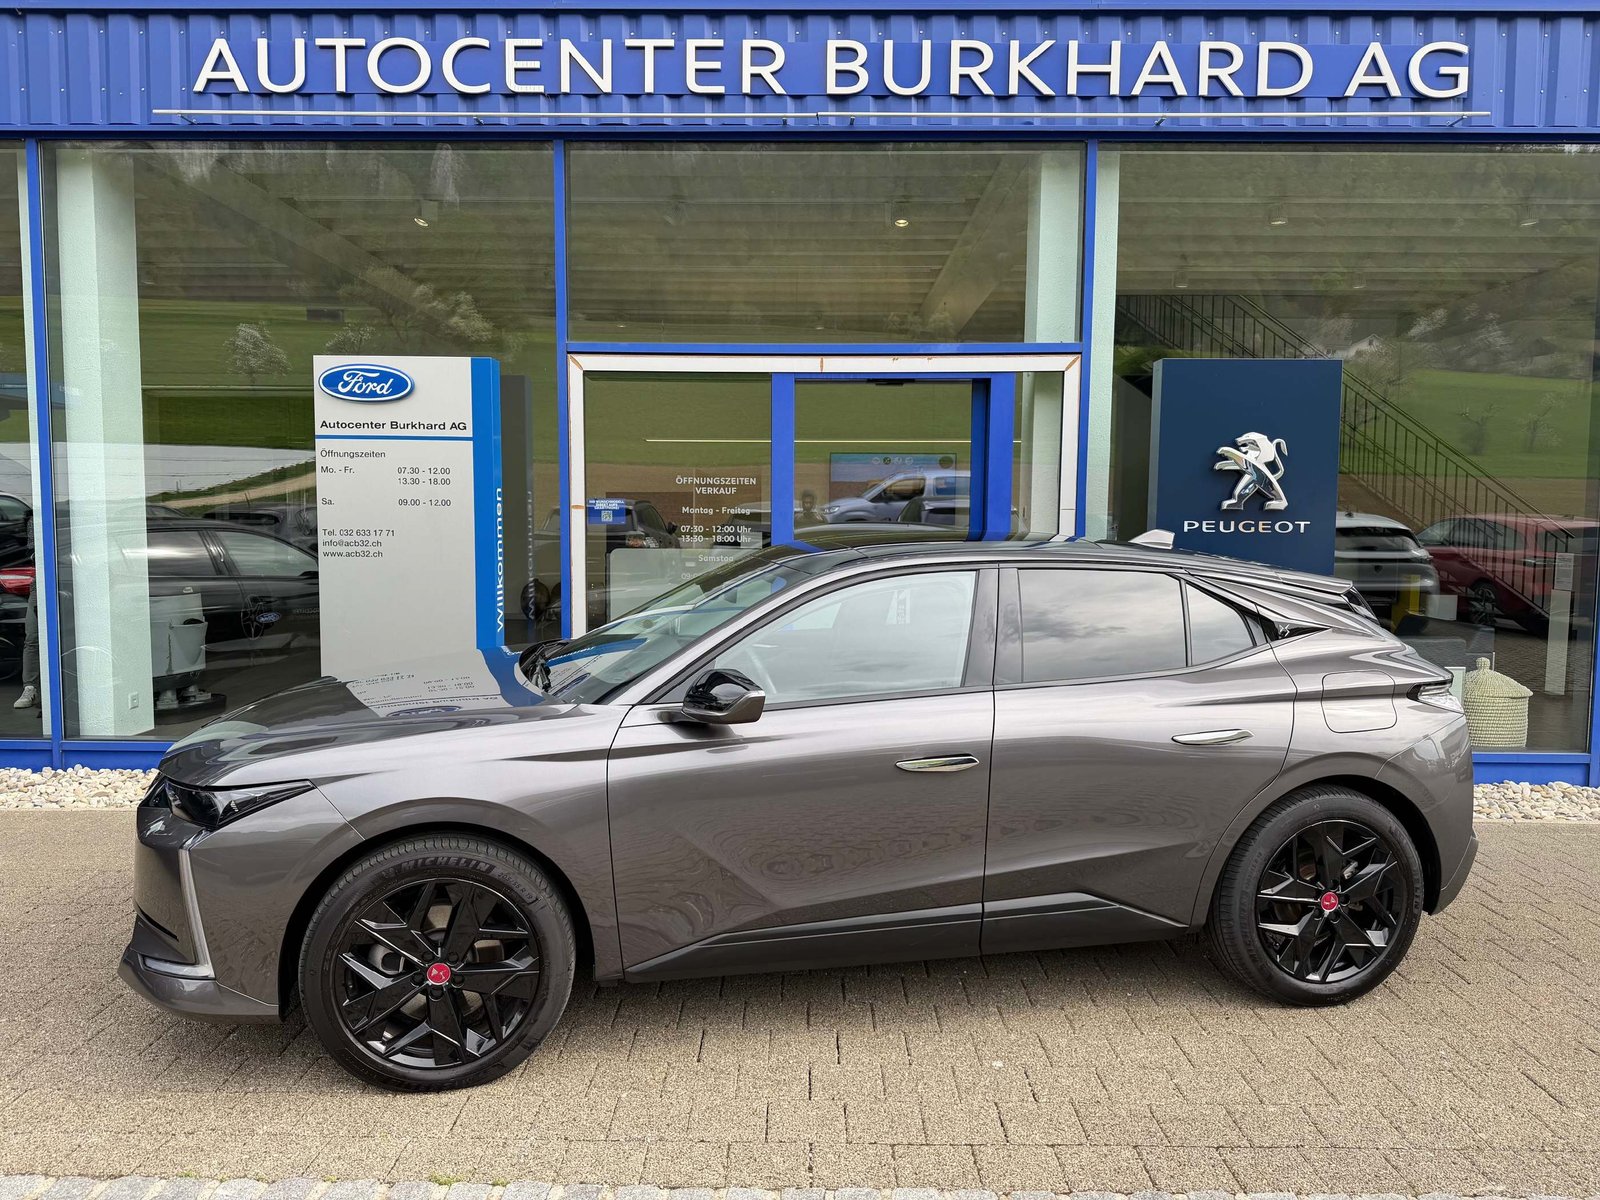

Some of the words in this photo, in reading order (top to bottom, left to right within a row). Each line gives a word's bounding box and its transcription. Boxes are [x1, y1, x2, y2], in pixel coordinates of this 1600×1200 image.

[192, 37, 788, 96] AUTOCENTER
[825, 39, 1313, 98] BURKHARD
[1344, 40, 1470, 99] AG
[337, 370, 394, 395] Ford
[320, 420, 387, 430] Autocenter
[390, 421, 446, 431] Burkhard
[449, 422, 467, 431] AG
[320, 448, 386, 459] Öffnungszeiten
[320, 466, 336, 474] Mo.
[397, 467, 420, 475] 07.30
[428, 467, 451, 475] 12.00
[428, 478, 451, 486] 18.00
[676, 475, 756, 485] ÖFFNUNGSZEITEN
[398, 499, 420, 507] 09.00
[429, 499, 452, 507] 12.00
[682, 506, 713, 515] Montag
[722, 507, 750, 515] Freitag
[680, 525, 704, 533] 07:30
[712, 525, 735, 533] 12:00
[736, 525, 751, 533] Uhr
[1183, 520, 1311, 534] PEUGEOT
[322, 529, 336, 537] Tel.
[339, 529, 354, 537] 032
[356, 529, 371, 537] 633
[373, 529, 383, 537] 17
[385, 529, 395, 537] 71
[681, 535, 704, 543] 13:30
[712, 535, 735, 543] 18:00
[736, 535, 751, 543] Uhr
[322, 550, 383, 558] www.acb32.ch
[401, 856, 491, 874] MICHELIN
